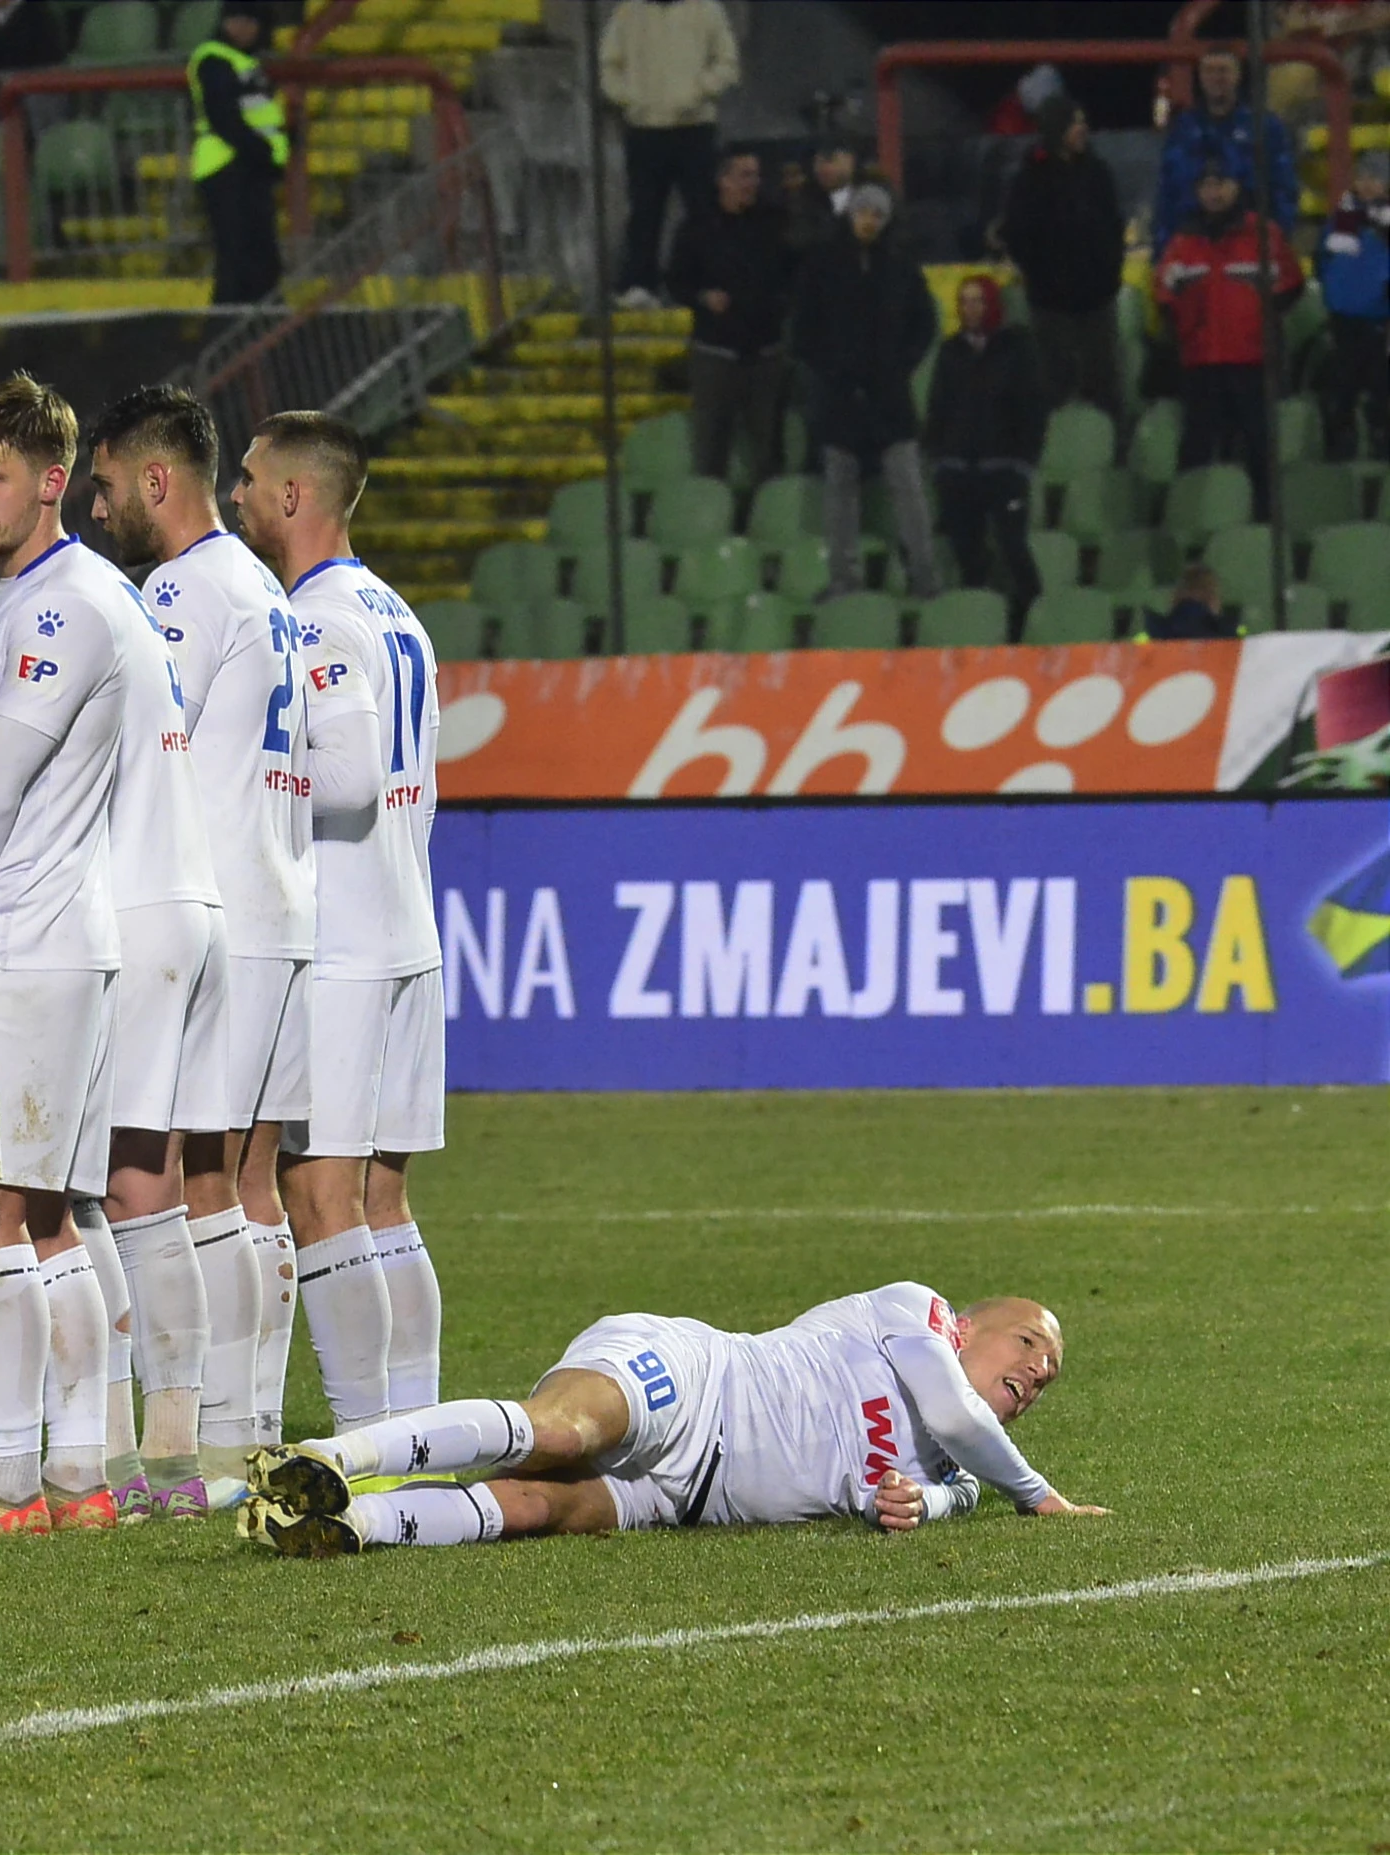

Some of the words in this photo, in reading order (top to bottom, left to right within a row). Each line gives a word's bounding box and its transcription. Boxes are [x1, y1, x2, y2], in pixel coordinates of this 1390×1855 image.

[18, 654, 59, 683] EP
[310, 663, 348, 692] EP
[382, 631, 426, 774] 17
[444, 886, 575, 1020] NA
[610, 874, 1277, 1020] ZMAJEVI.BA
[627, 1350, 677, 1412] 90
